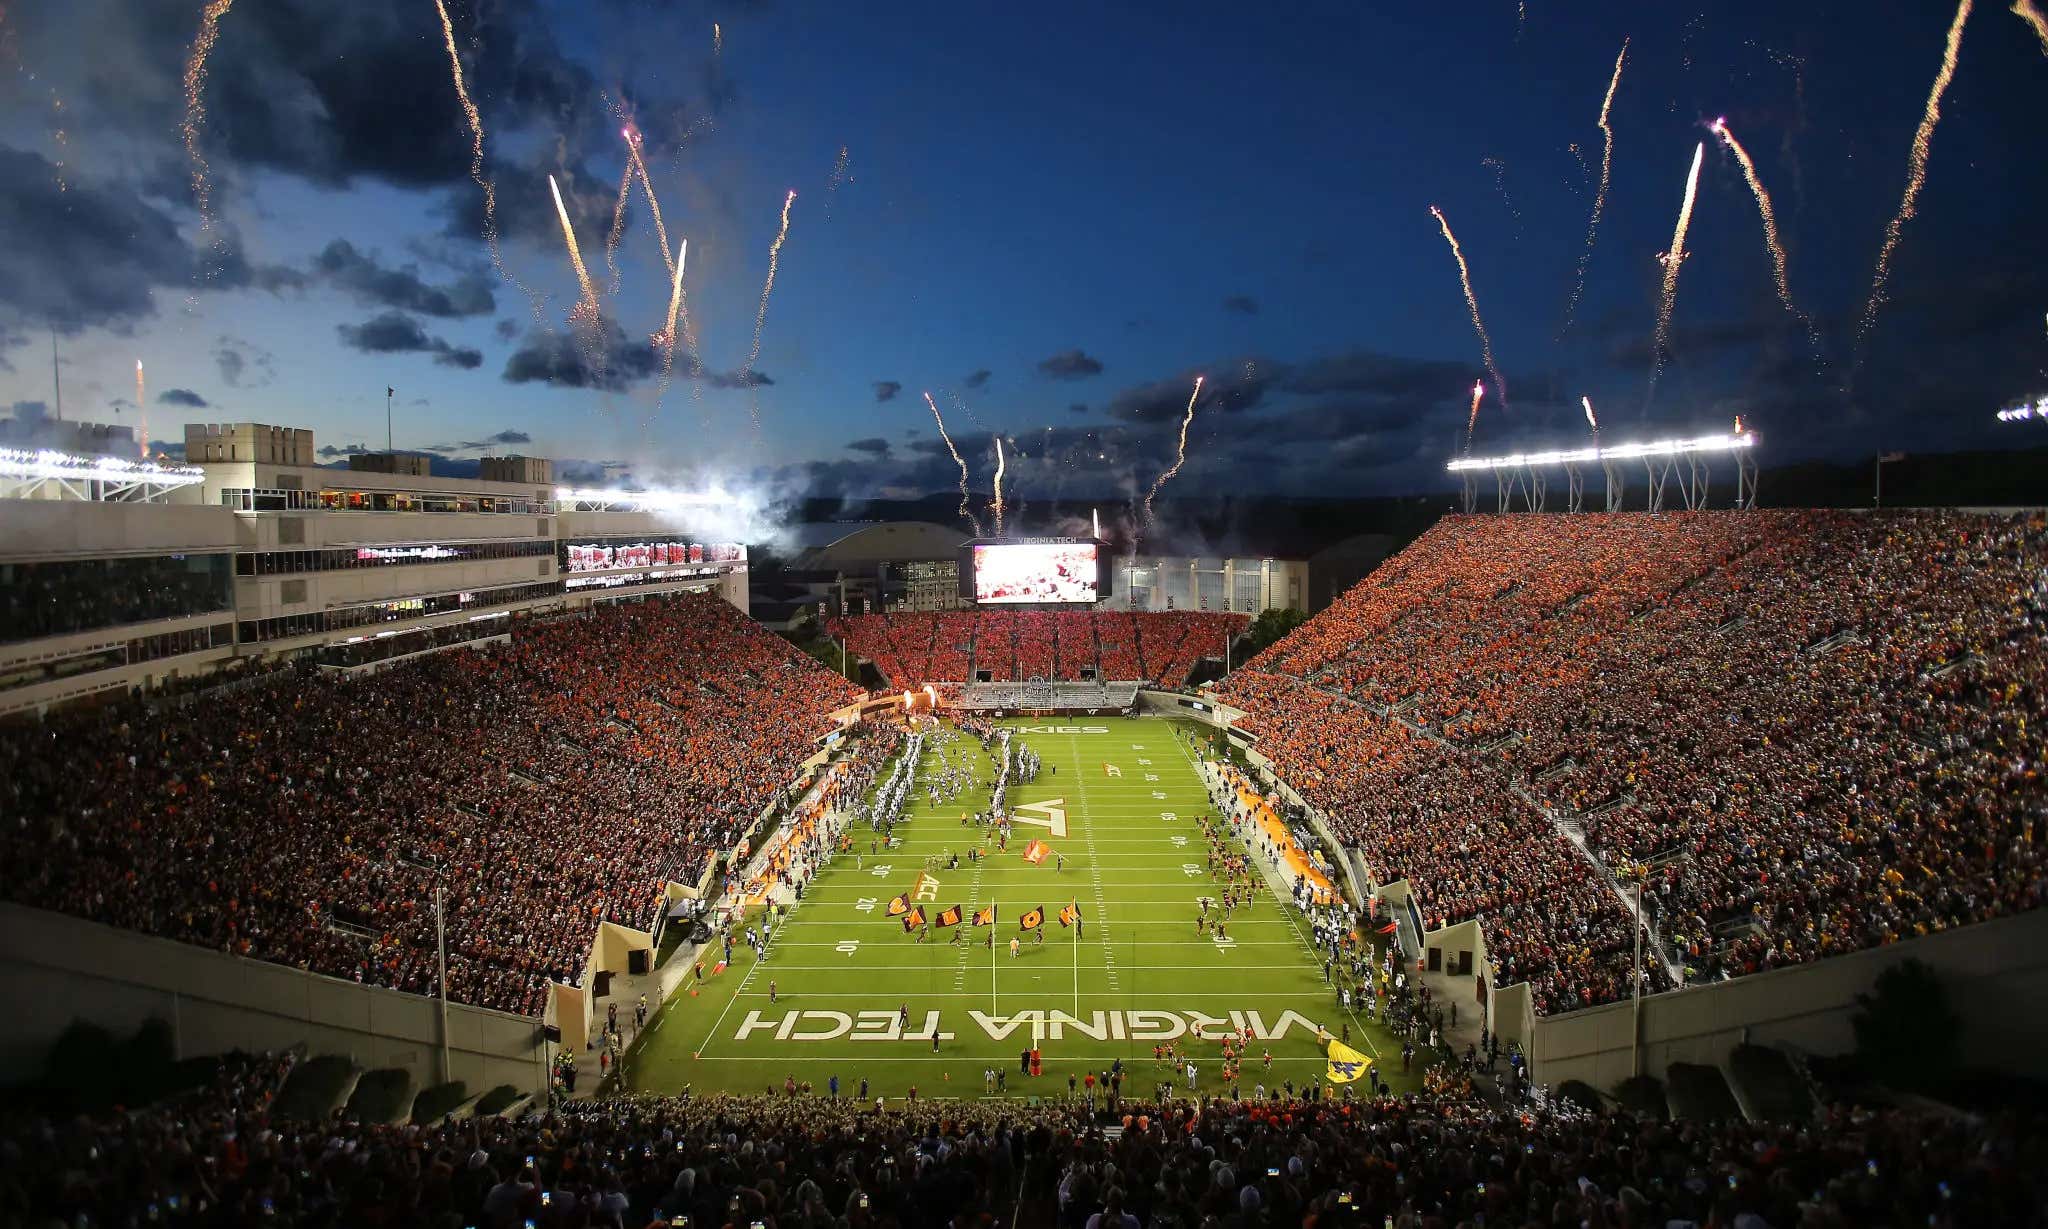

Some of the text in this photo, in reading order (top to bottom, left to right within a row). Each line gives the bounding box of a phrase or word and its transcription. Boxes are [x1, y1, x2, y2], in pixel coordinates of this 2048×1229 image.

[1018, 536, 1077, 544] VIRGINIA TECH
[1087, 708, 1099, 716] VT
[1160, 812, 1177, 821] 50
[872, 865, 892, 875] 30
[1182, 863, 1202, 875] 30
[917, 873, 940, 902] ACC
[855, 897, 878, 910] 20
[835, 939, 860, 952] 10
[1213, 936, 1237, 948] 10
[734, 1010, 1338, 1040] VIRGINIA TECH
